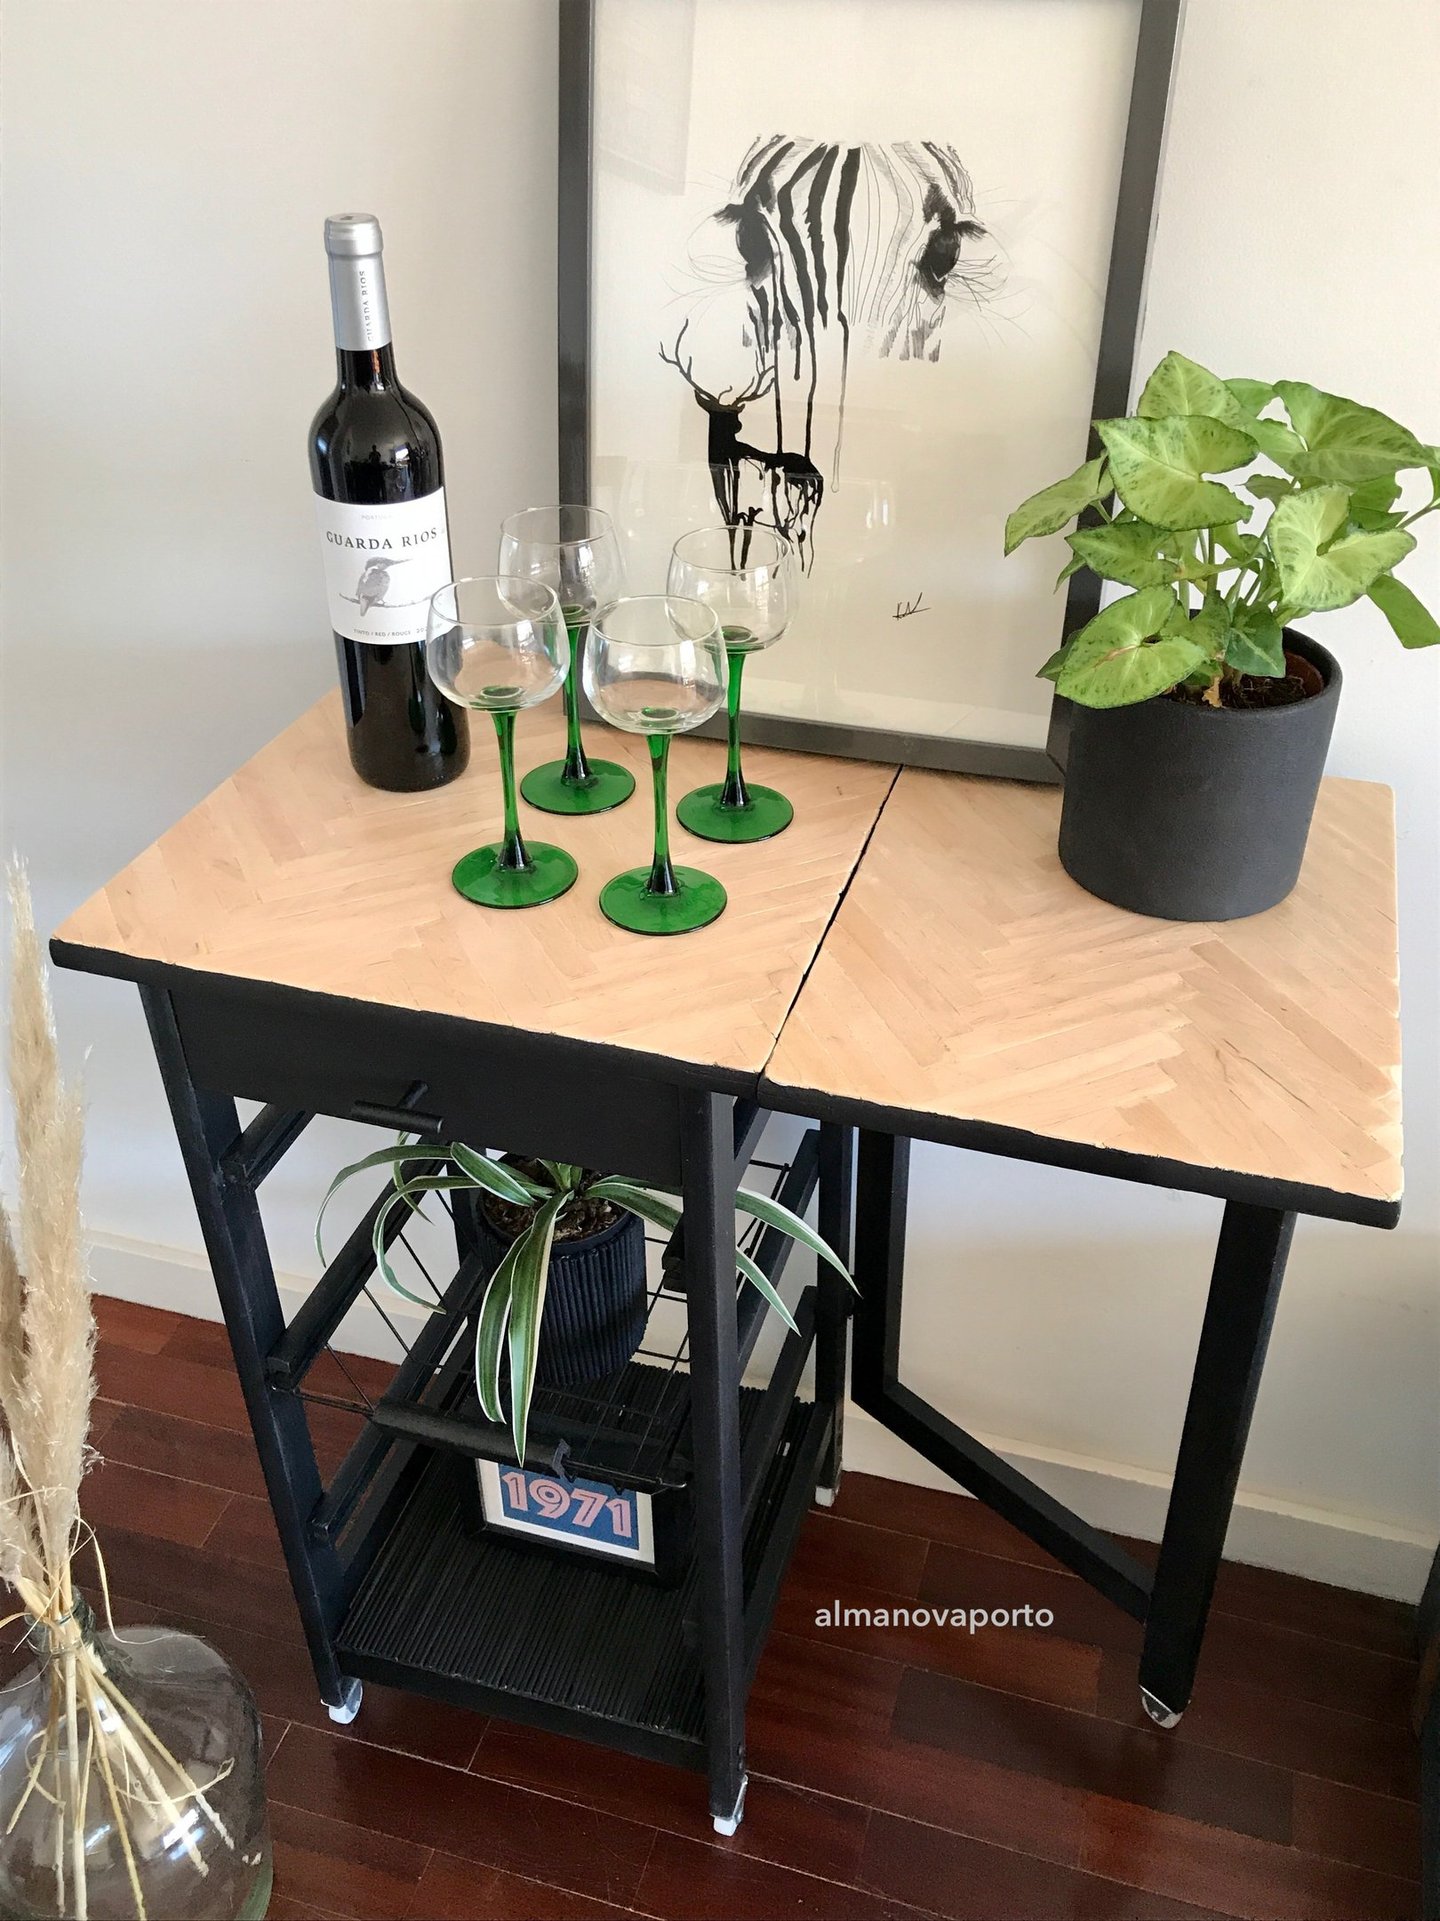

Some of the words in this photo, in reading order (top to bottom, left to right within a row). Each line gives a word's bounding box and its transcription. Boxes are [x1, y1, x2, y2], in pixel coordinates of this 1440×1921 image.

[359, 270, 368, 296] RIOS
[362, 300, 373, 342] GUARDA
[326, 531, 393, 550] GUARDA
[402, 527, 437, 547] RIOS
[501, 1471, 632, 1538] 1971
